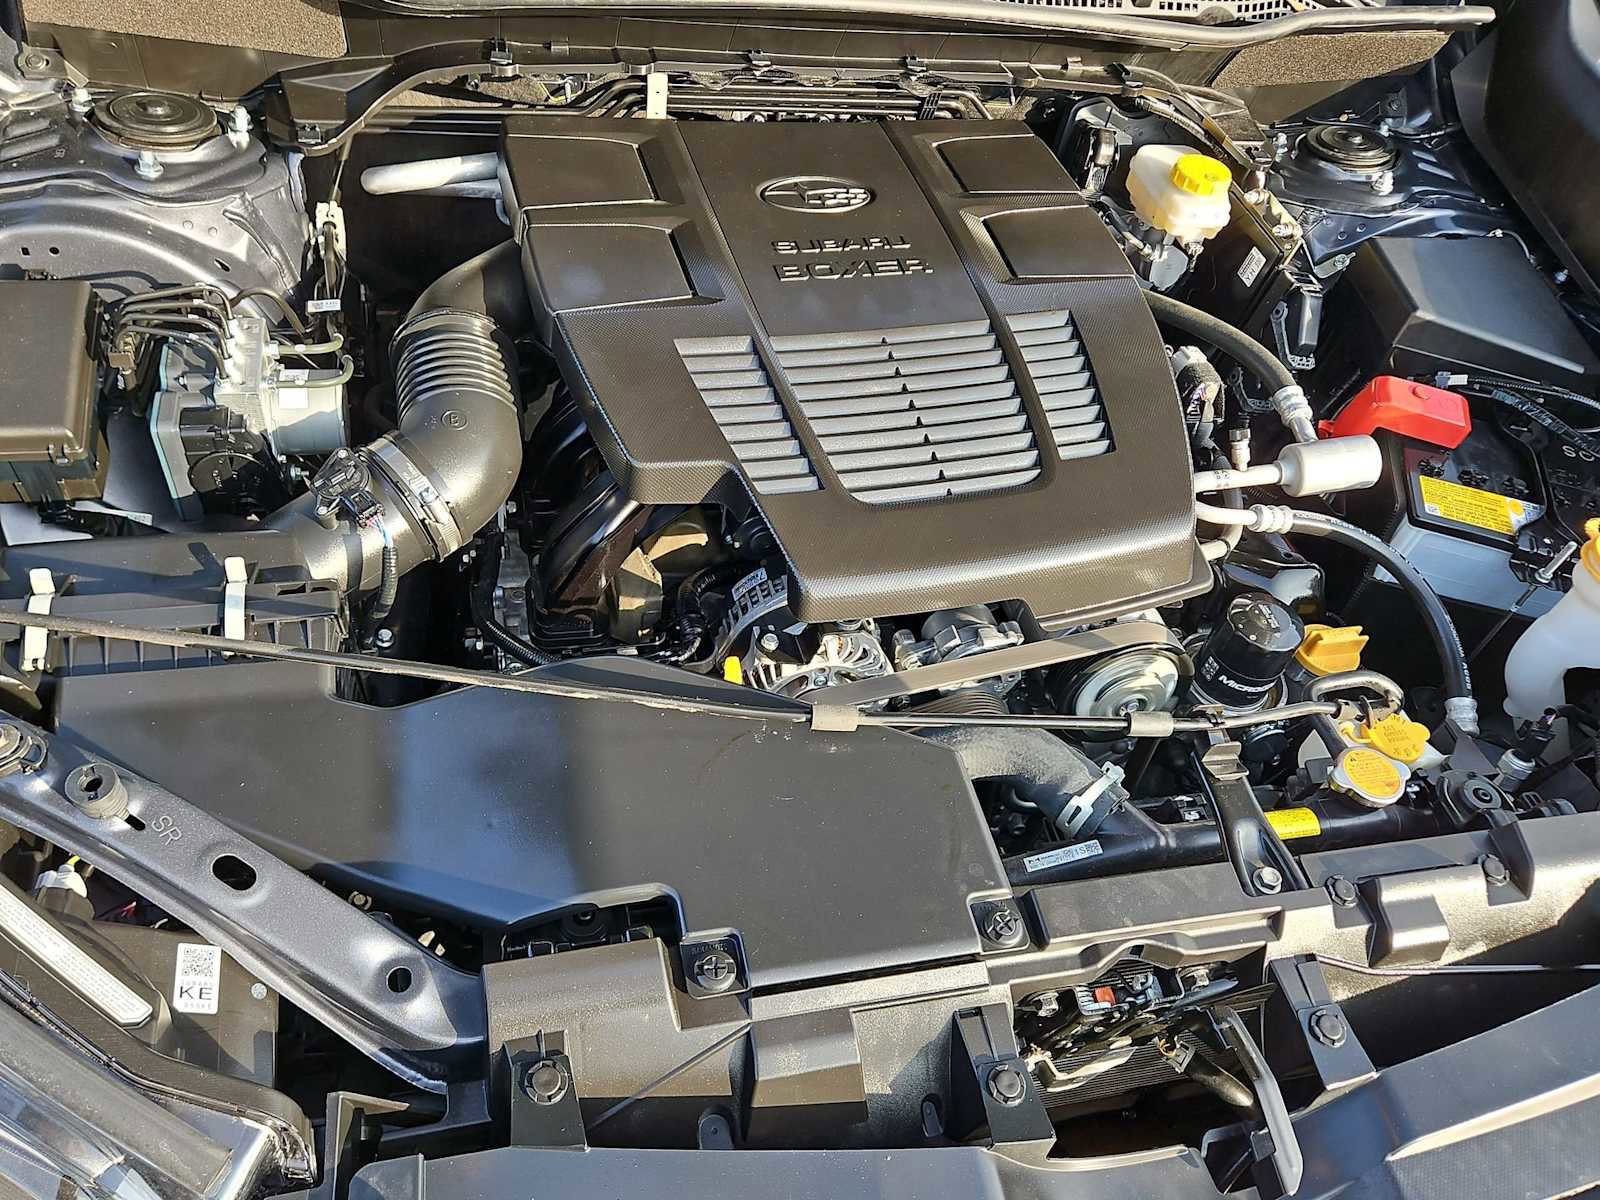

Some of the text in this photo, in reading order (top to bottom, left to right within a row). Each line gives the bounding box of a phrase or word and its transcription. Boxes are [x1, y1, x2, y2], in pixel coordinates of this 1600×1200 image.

[772, 236, 912, 255] SUBARU
[773, 258, 934, 282] BOXER
[151, 815, 182, 846] SR
[179, 985, 214, 1001] KE
